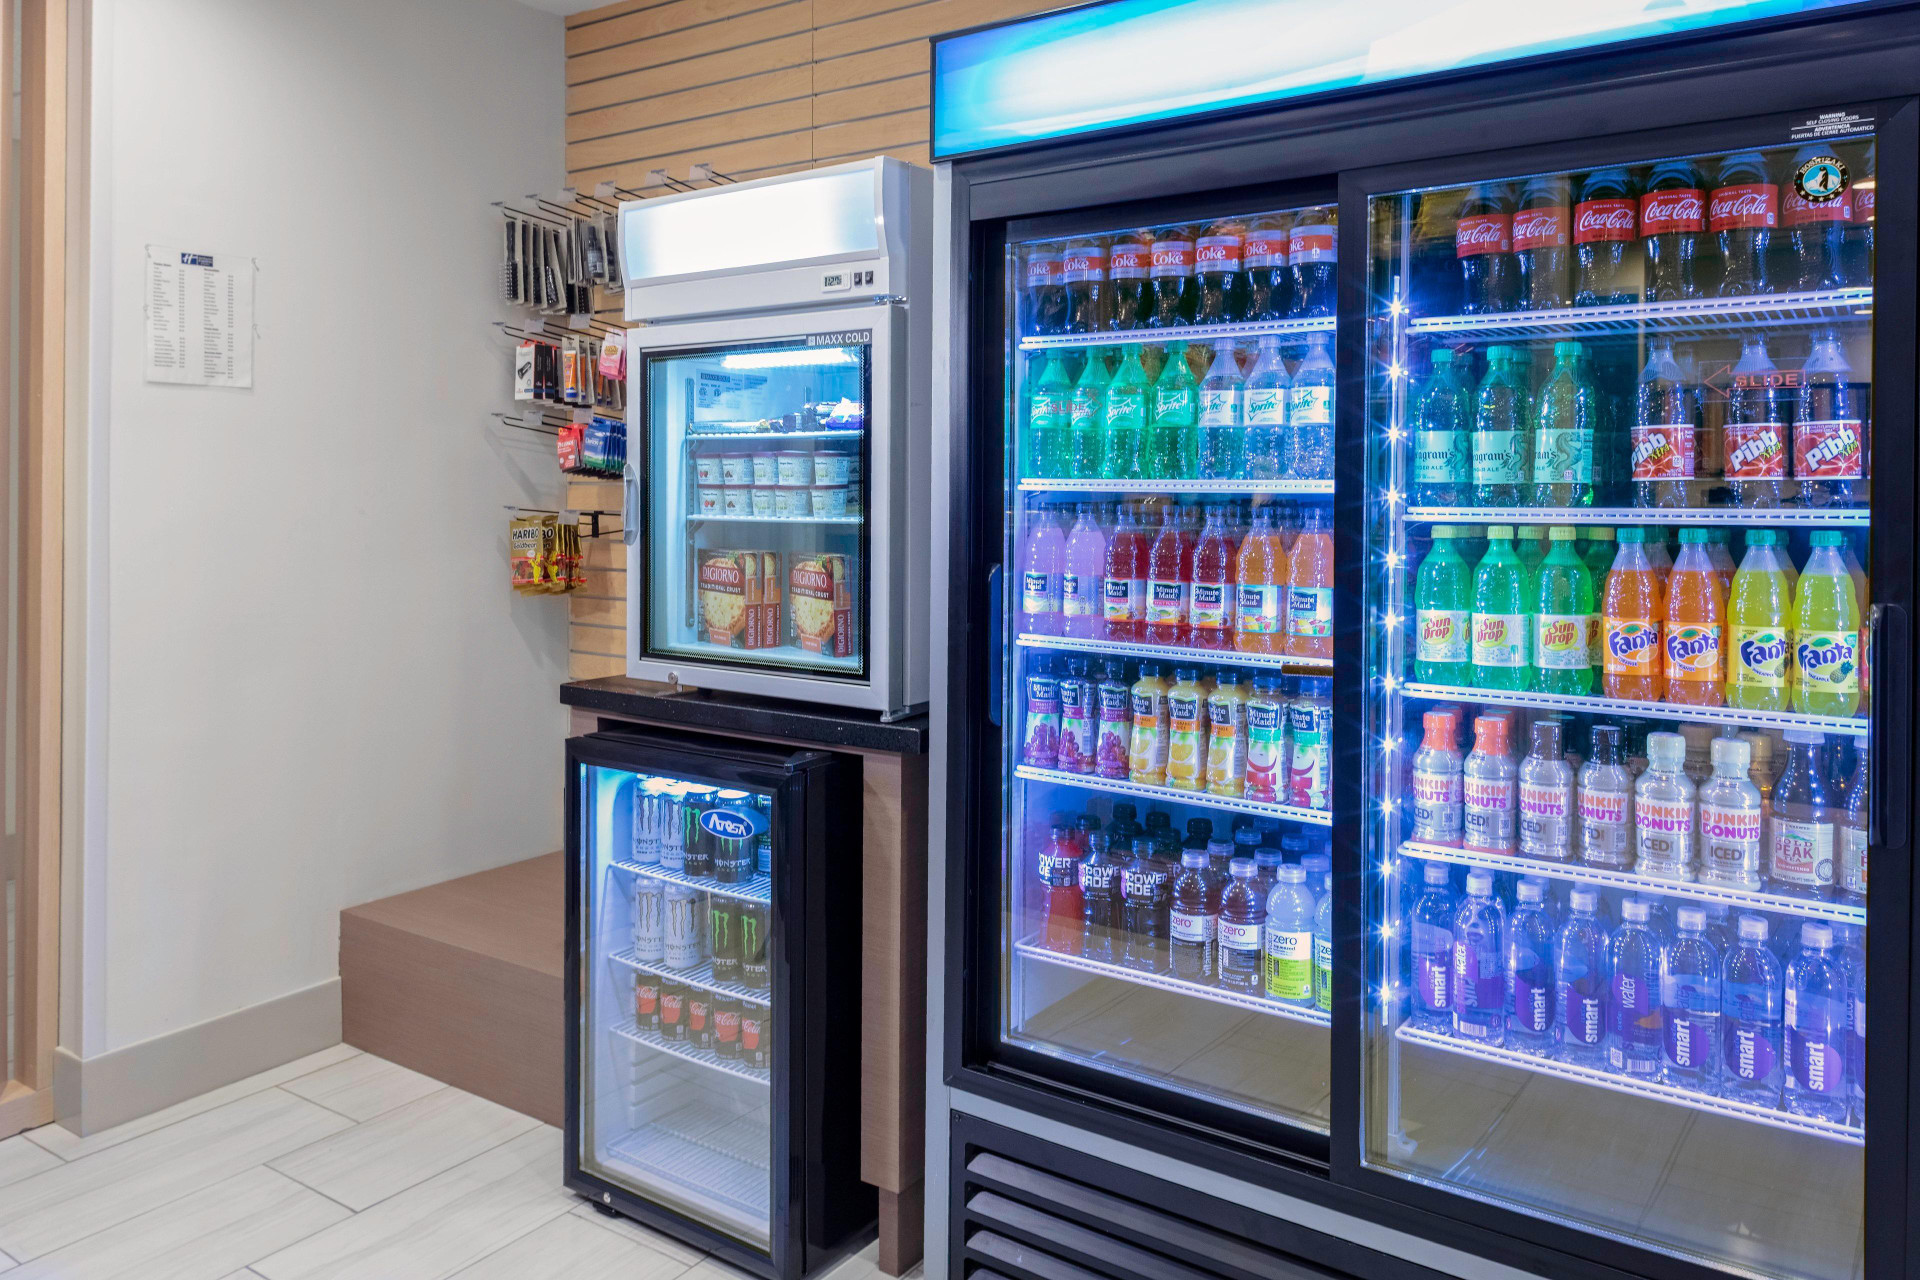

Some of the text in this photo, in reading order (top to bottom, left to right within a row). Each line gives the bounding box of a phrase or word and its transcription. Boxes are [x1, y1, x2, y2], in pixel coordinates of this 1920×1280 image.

[1800, 157, 1846, 175] HOSHIZAKI
[1645, 198, 1704, 223] Coca-Cola
[1710, 193, 1769, 221] Coca-Cola
[1580, 208, 1635, 232] Coca-Cola
[1196, 246, 1226, 262] Coke
[1289, 239, 1304, 254] oke
[1064, 257, 1089, 272] Coke
[1111, 255, 1138, 268] Coke
[1153, 251, 1183, 266] Coke
[816, 332, 869, 345] MAXX COLD
[1736, 373, 1798, 386] SLIDE
[1108, 404, 1134, 418] Sprite
[1250, 400, 1278, 414] Sprite
[1631, 432, 1667, 473] Pibb
[1648, 443, 1672, 461] Xtra
[1729, 430, 1778, 473] Pibb
[1759, 442, 1783, 461] Xtra
[1805, 427, 1856, 472] Pibb
[702, 566, 740, 584] DIGIORNO
[793, 571, 828, 589] DIGIORNO
[1156, 585, 1180, 595] Minute
[1195, 588, 1221, 597] Minute
[747, 608, 756, 647] DIGIORNO
[1426, 617, 1450, 630] Sun
[1482, 618, 1504, 631] Sun
[1548, 621, 1575, 634] Sun
[837, 614, 845, 654] DIGIORNO
[1423, 627, 1450, 641] Drop
[1477, 629, 1503, 643] Drop
[1544, 630, 1574, 646] Drop
[1609, 629, 1658, 657] Fanta
[1667, 633, 1718, 662] Fanta
[1797, 642, 1853, 671] Fanta
[1249, 708, 1276, 719] Minute
[1251, 717, 1274, 727] Maid
[1464, 780, 1510, 798] UNKIN'
[1520, 787, 1567, 805] UNKIN'
[1578, 793, 1626, 811] UNKIN'
[1413, 808, 1430, 820] CED
[1466, 813, 1486, 827] CED
[708, 813, 747, 836] ATOSA
[1521, 819, 1542, 834] CED
[1635, 814, 1692, 832] DONUTS
[1702, 823, 1760, 840] DONUTS
[1641, 835, 1671, 854] ICED
[1776, 837, 1813, 848] GOLD
[1710, 846, 1742, 862] ICED
[1776, 843, 1814, 860] PEAK
[1038, 852, 1071, 869] OWER
[1125, 870, 1169, 885] POWER
[1125, 883, 1154, 897] ADE
[1172, 916, 1192, 929] zero
[1223, 925, 1246, 942] zero
[1273, 934, 1298, 946] zero
[1320, 944, 1332, 956] ze
[1456, 940, 1467, 977] water
[1432, 965, 1446, 1008] smart
[1622, 973, 1636, 1010] water
[1531, 986, 1546, 1032] smart
[1582, 997, 1599, 1044] smart
[1673, 1017, 1690, 1067] smart
[1736, 1029, 1755, 1079] smart
[1805, 1041, 1825, 1092] smart
